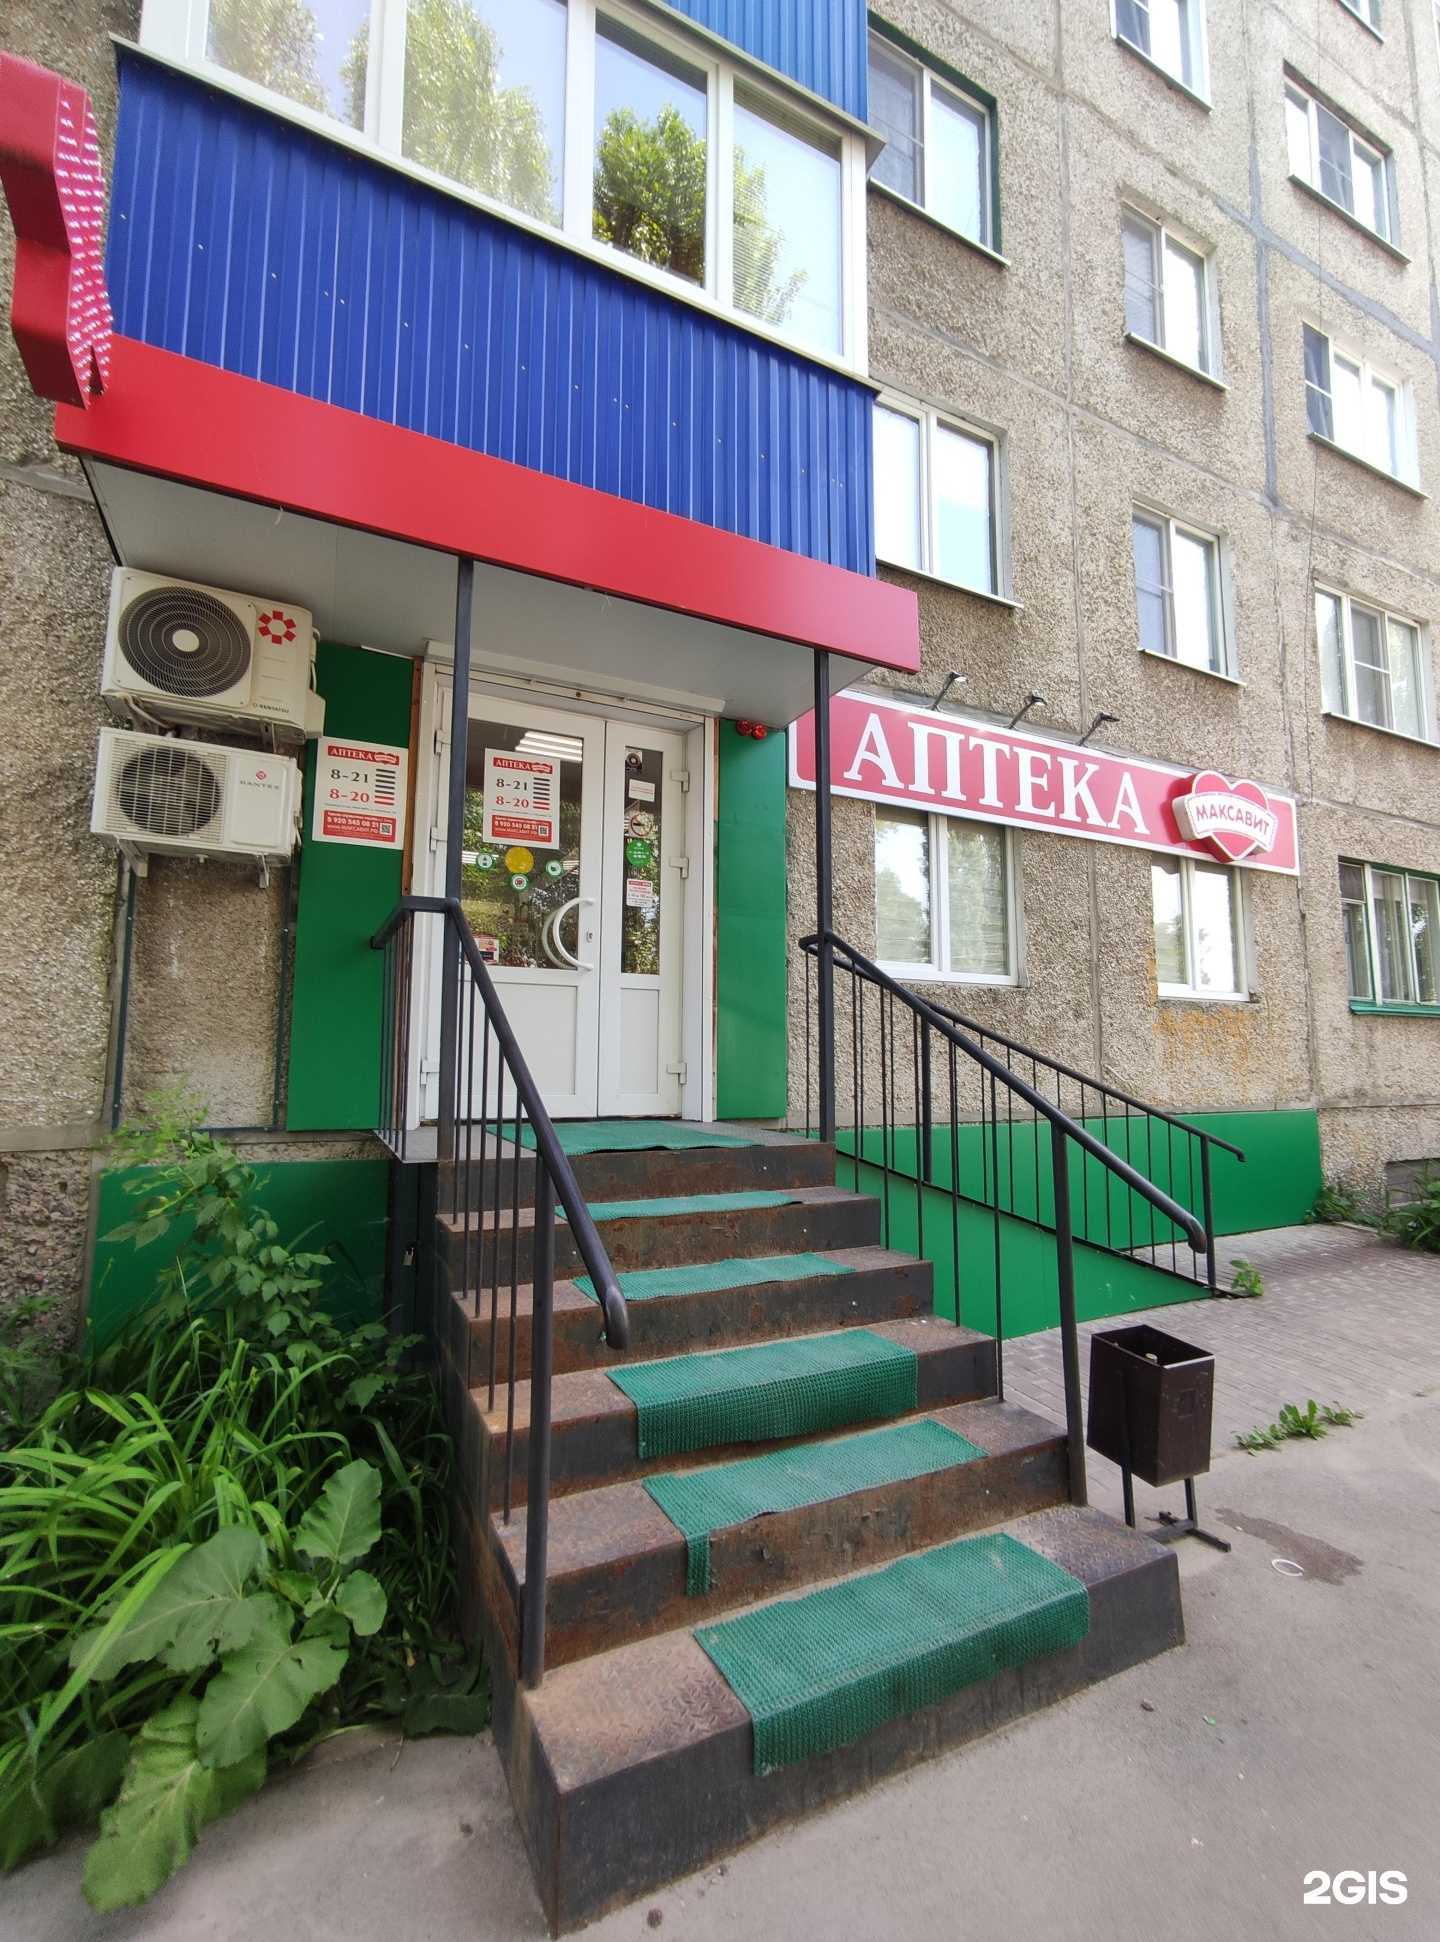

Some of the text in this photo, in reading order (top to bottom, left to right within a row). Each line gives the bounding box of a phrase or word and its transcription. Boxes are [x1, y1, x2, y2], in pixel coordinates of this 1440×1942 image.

[330, 747, 373, 760] АПТЕКА
[496, 759, 531, 770] АПТЕКА
[843, 712, 1151, 836] АПТЕКА
[1196, 803, 1270, 835] МАКСАВИТ
